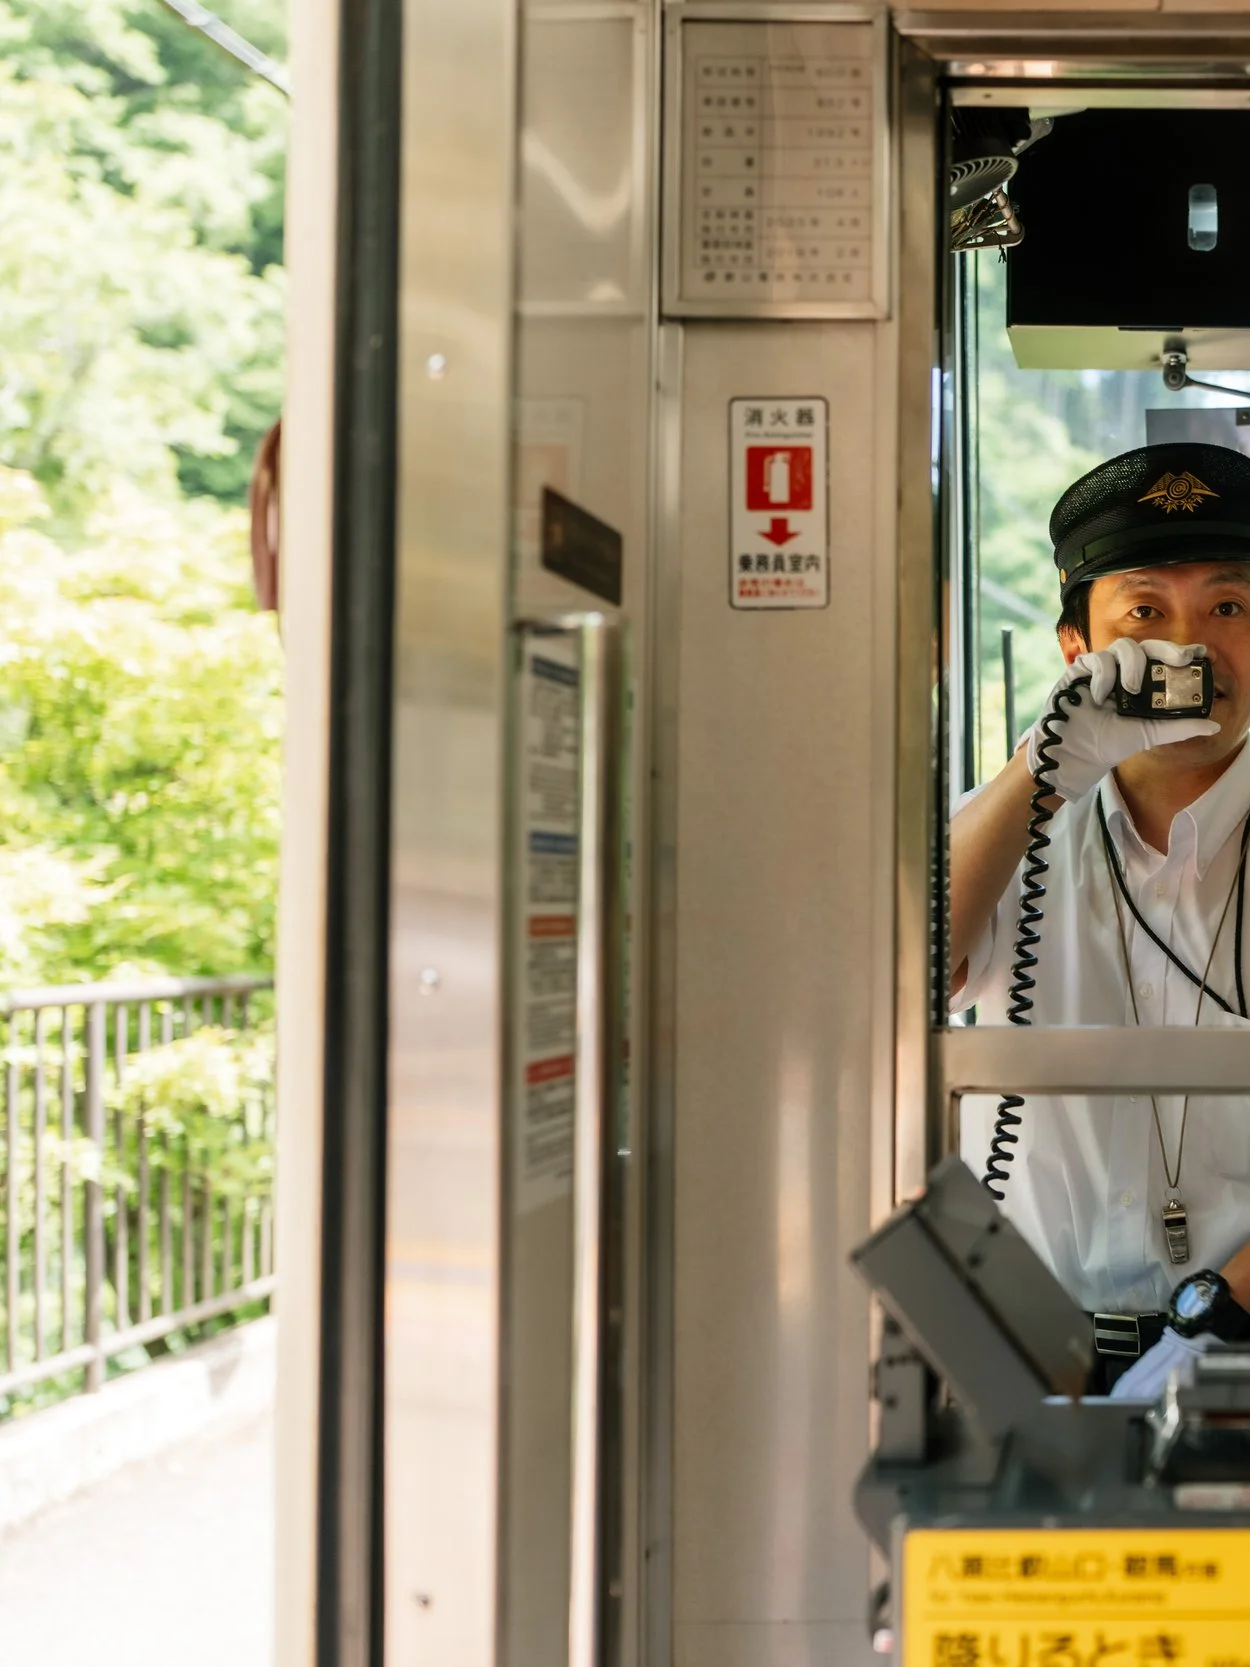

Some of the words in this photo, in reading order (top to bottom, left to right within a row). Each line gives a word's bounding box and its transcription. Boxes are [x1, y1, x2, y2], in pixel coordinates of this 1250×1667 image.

[744, 407, 815, 426] 消火器
[739, 553, 820, 573] 乗務員室内
